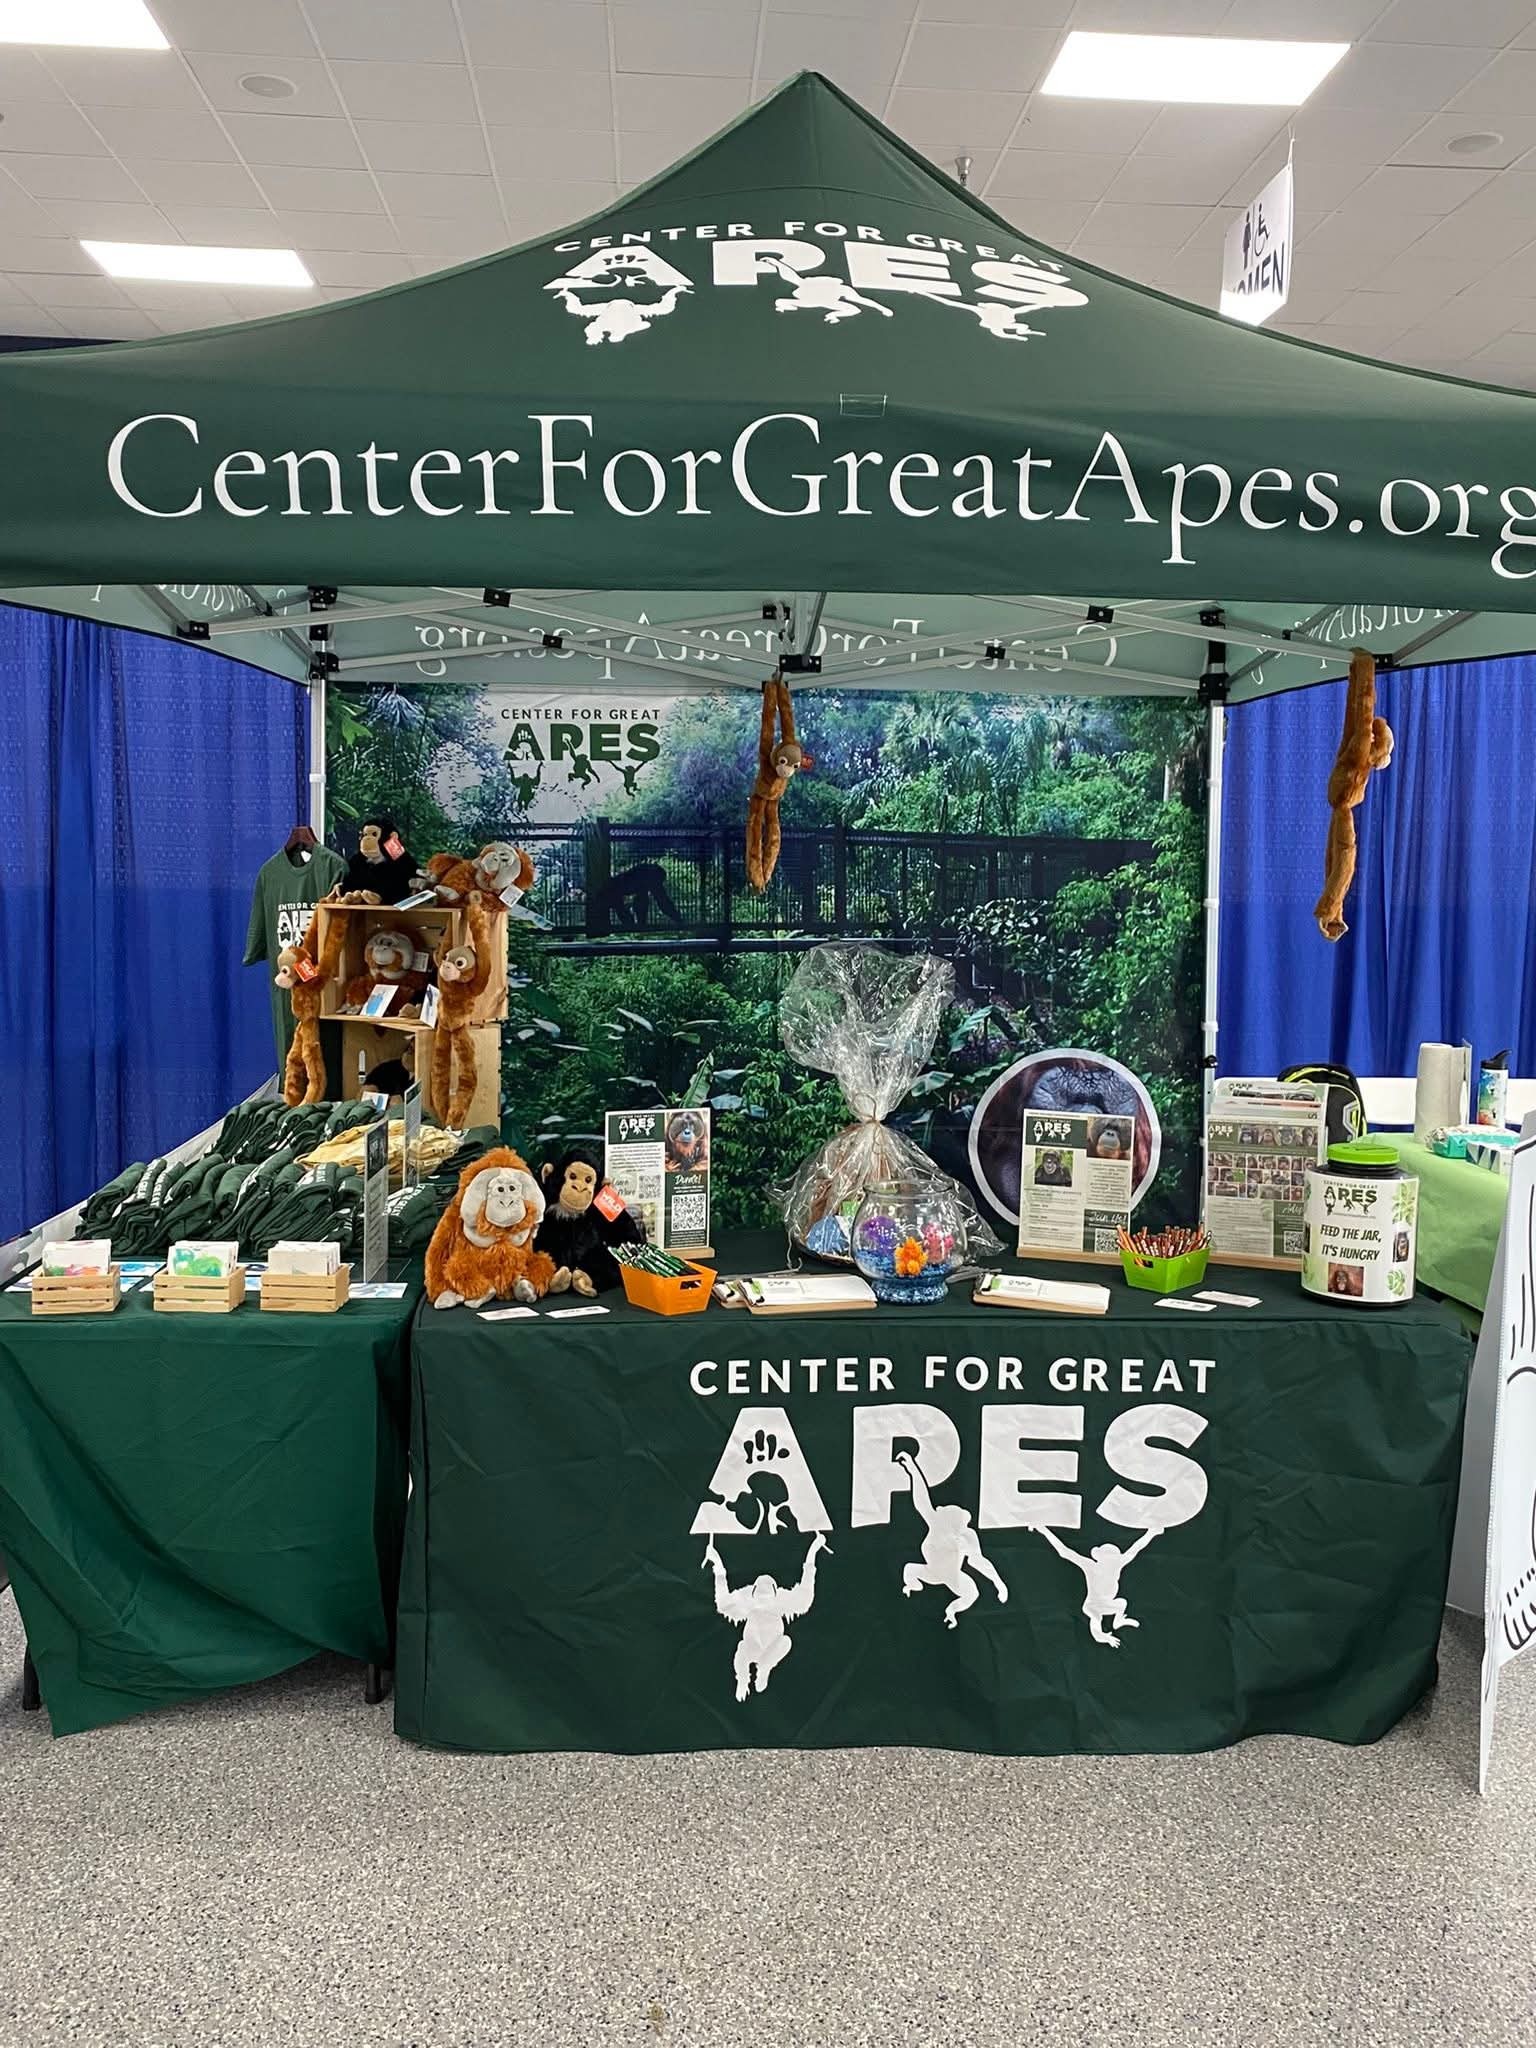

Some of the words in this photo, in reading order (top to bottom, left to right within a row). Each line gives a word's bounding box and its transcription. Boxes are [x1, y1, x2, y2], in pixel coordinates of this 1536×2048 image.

[553, 222, 753, 252] CENTER
[784, 221, 884, 242] FOR
[907, 233, 1066, 273] GREAT
[543, 239, 1089, 307] APES
[1234, 242, 1285, 296] OMEN
[107, 413, 1536, 579] CenterForGreatApes.org
[501, 709, 562, 720] CENTER
[571, 709, 602, 719] FOR
[609, 709, 660, 719] GREAT
[502, 723, 661, 761] APES
[619, 1117, 655, 1129] APES
[1034, 1121, 1071, 1133] APES
[1324, 1186, 1377, 1203] APES
[1320, 1224, 1340, 1237] FEED
[1342, 1227, 1359, 1239] THE
[1360, 1230, 1381, 1242] JAR,
[1322, 1244, 1338, 1256] IT'S
[1339, 1247, 1380, 1260] HUNGRY
[689, 1357, 894, 1395] CENTER
[924, 1356, 1024, 1391] FOR
[1048, 1357, 1216, 1394] GREAT
[689, 1403, 1209, 1534] APES
